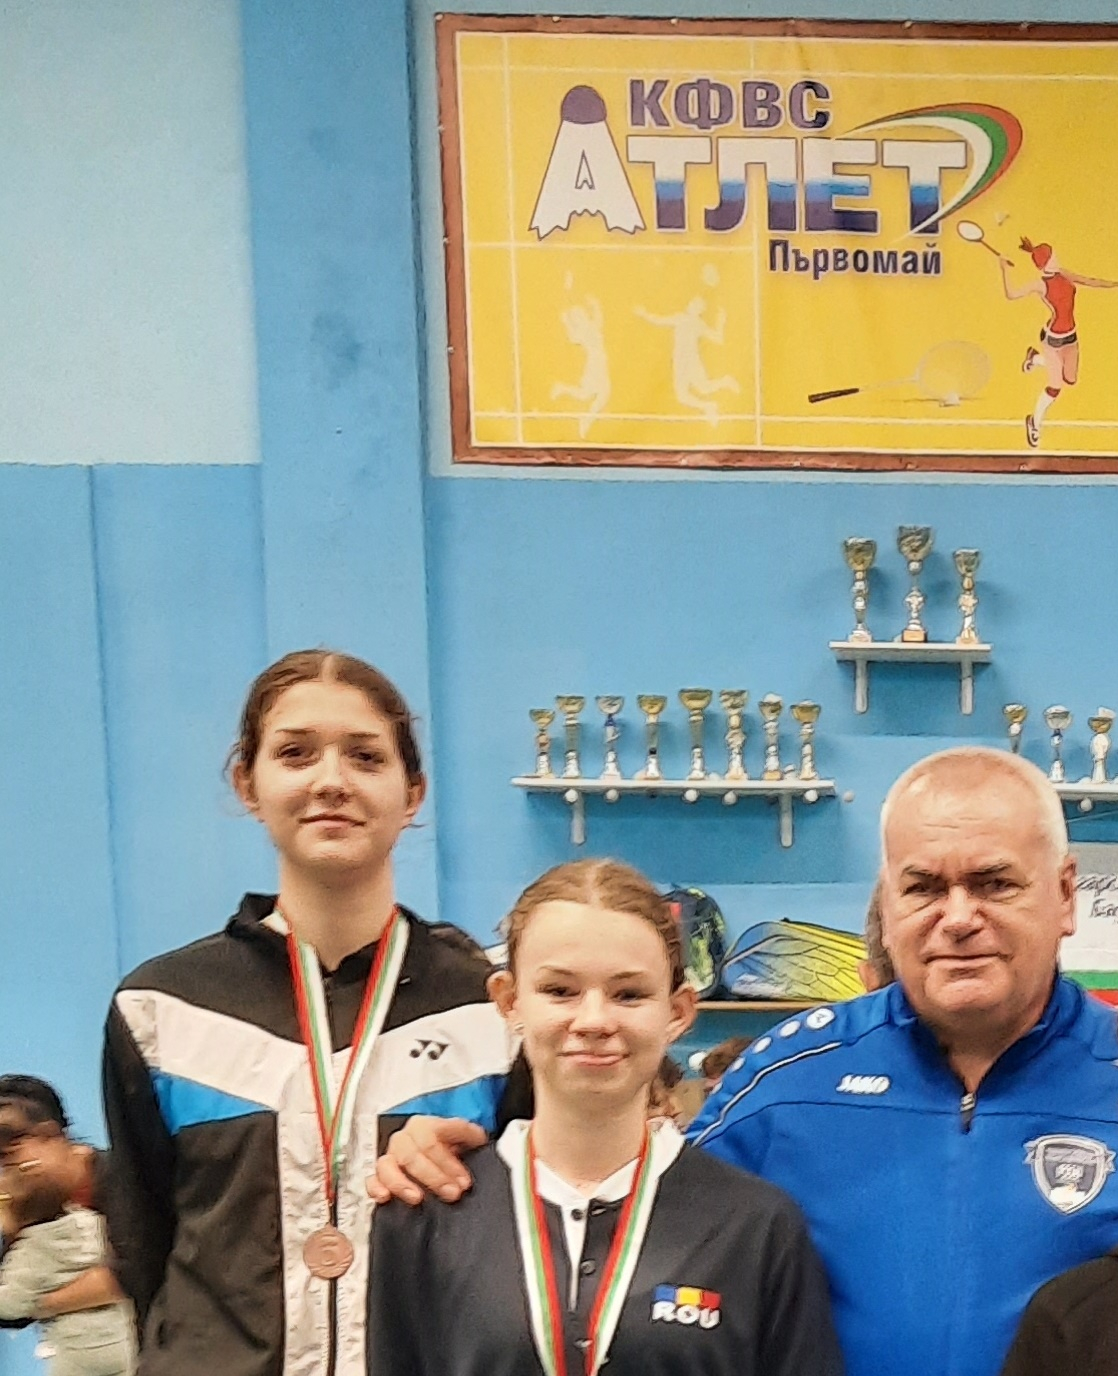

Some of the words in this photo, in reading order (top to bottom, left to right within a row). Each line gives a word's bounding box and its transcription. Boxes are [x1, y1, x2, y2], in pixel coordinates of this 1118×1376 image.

[628, 78, 831, 131] КФВС
[768, 241, 942, 279] Първомай
[652, 1300, 720, 1329] ROU
